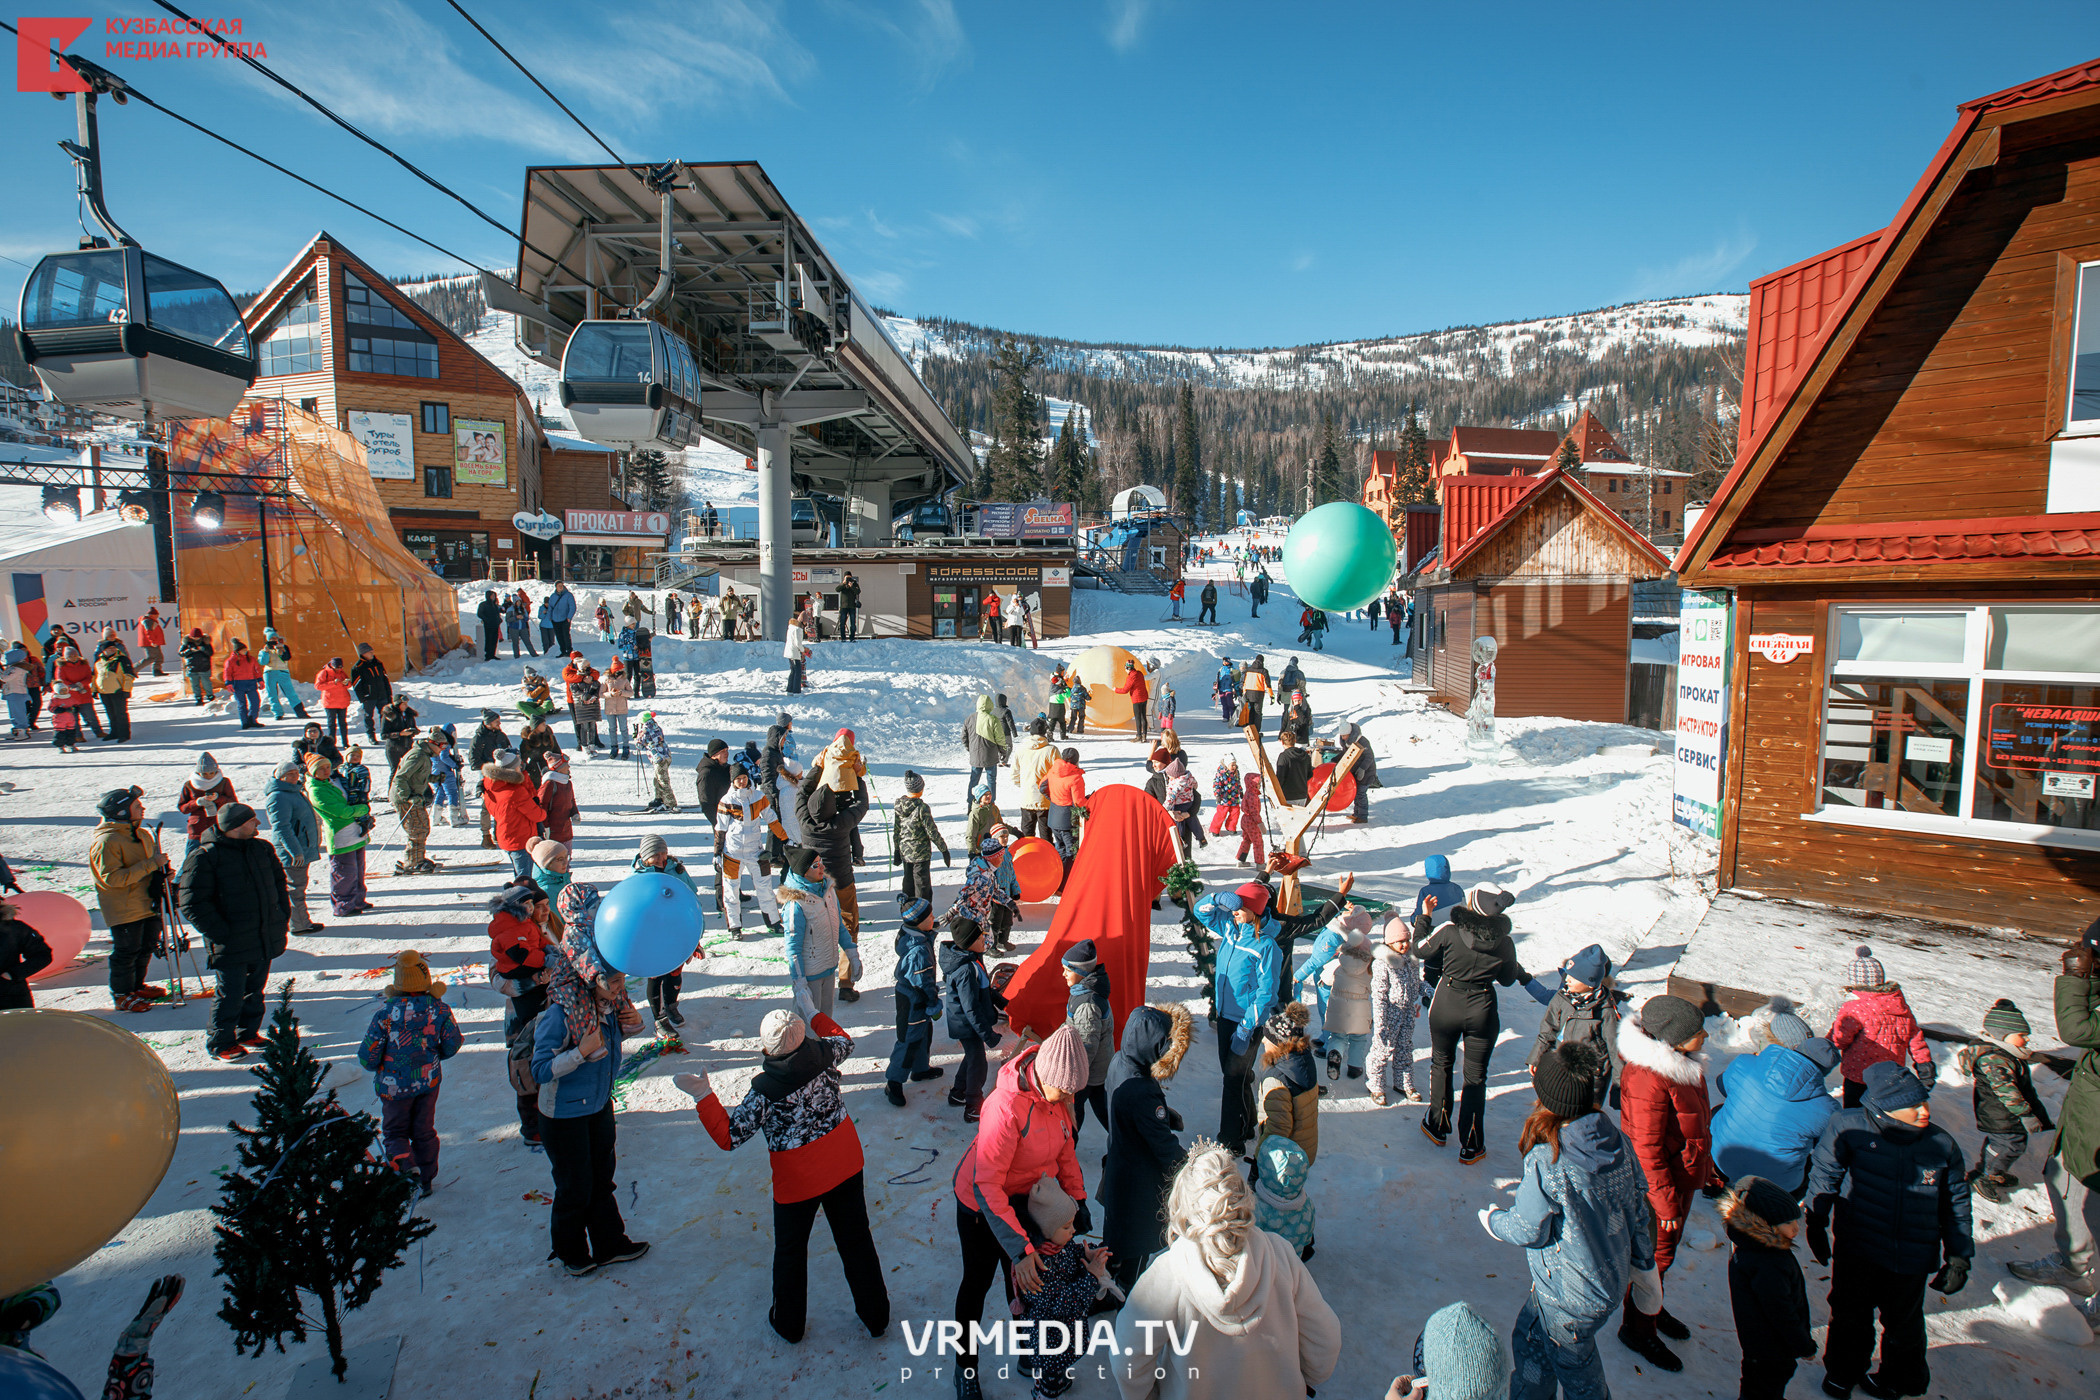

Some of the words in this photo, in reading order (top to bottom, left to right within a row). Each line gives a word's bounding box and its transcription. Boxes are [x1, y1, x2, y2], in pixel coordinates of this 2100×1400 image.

[108, 308, 128, 324] 42
[637, 371, 651, 383] 14
[367, 430, 395, 439] Туры
[372, 440, 400, 448] отель
[367, 446, 401, 456] Сугроб
[515, 518, 560, 532] Сугроб
[568, 512, 626, 530] ПРОКАТ
[407, 535, 436, 543] КАФЕ
[792, 571, 808, 581] ССЫ
[940, 567, 1038, 576] dresscode
[66, 616, 179, 635] ЭКИПИУ
[1751, 640, 1809, 649] СНЕЖНАЯ
[1681, 653, 1720, 669] ИГРОВАЯ
[1770, 650, 1786, 660] 44
[1680, 685, 1720, 704] ПРОКАТ
[1678, 716, 1718, 738] ИНСТРУКТОР
[1678, 747, 1717, 771] СЕРВИС
